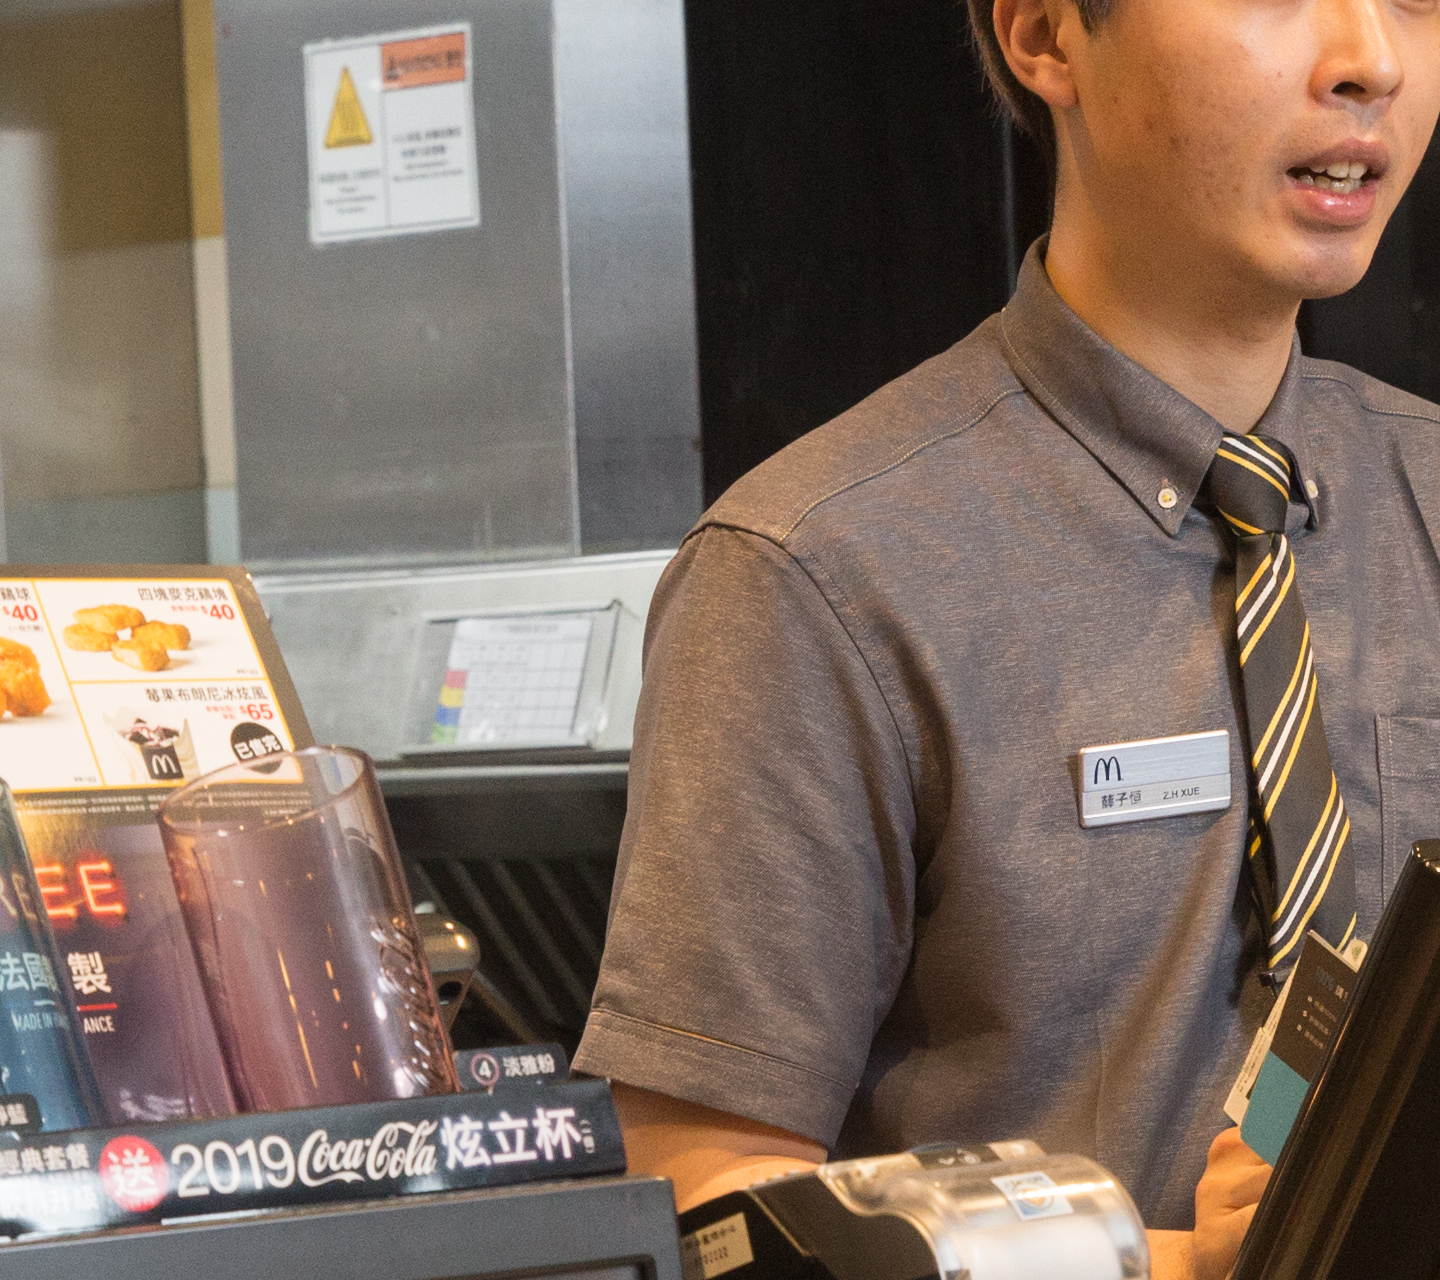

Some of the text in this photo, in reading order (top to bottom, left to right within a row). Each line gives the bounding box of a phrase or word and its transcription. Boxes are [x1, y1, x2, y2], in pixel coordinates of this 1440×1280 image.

[3, 605, 38, 621] $40
[201, 605, 235, 620] $40
[240, 705, 274, 720] $65
[235, 736, 281, 760] 已售完
[1181, 787, 1200, 797] XUE
[109, 1147, 159, 1197] 送
[172, 1136, 296, 1197] 2019
[440, 1108, 583, 1171] 炫立杯
